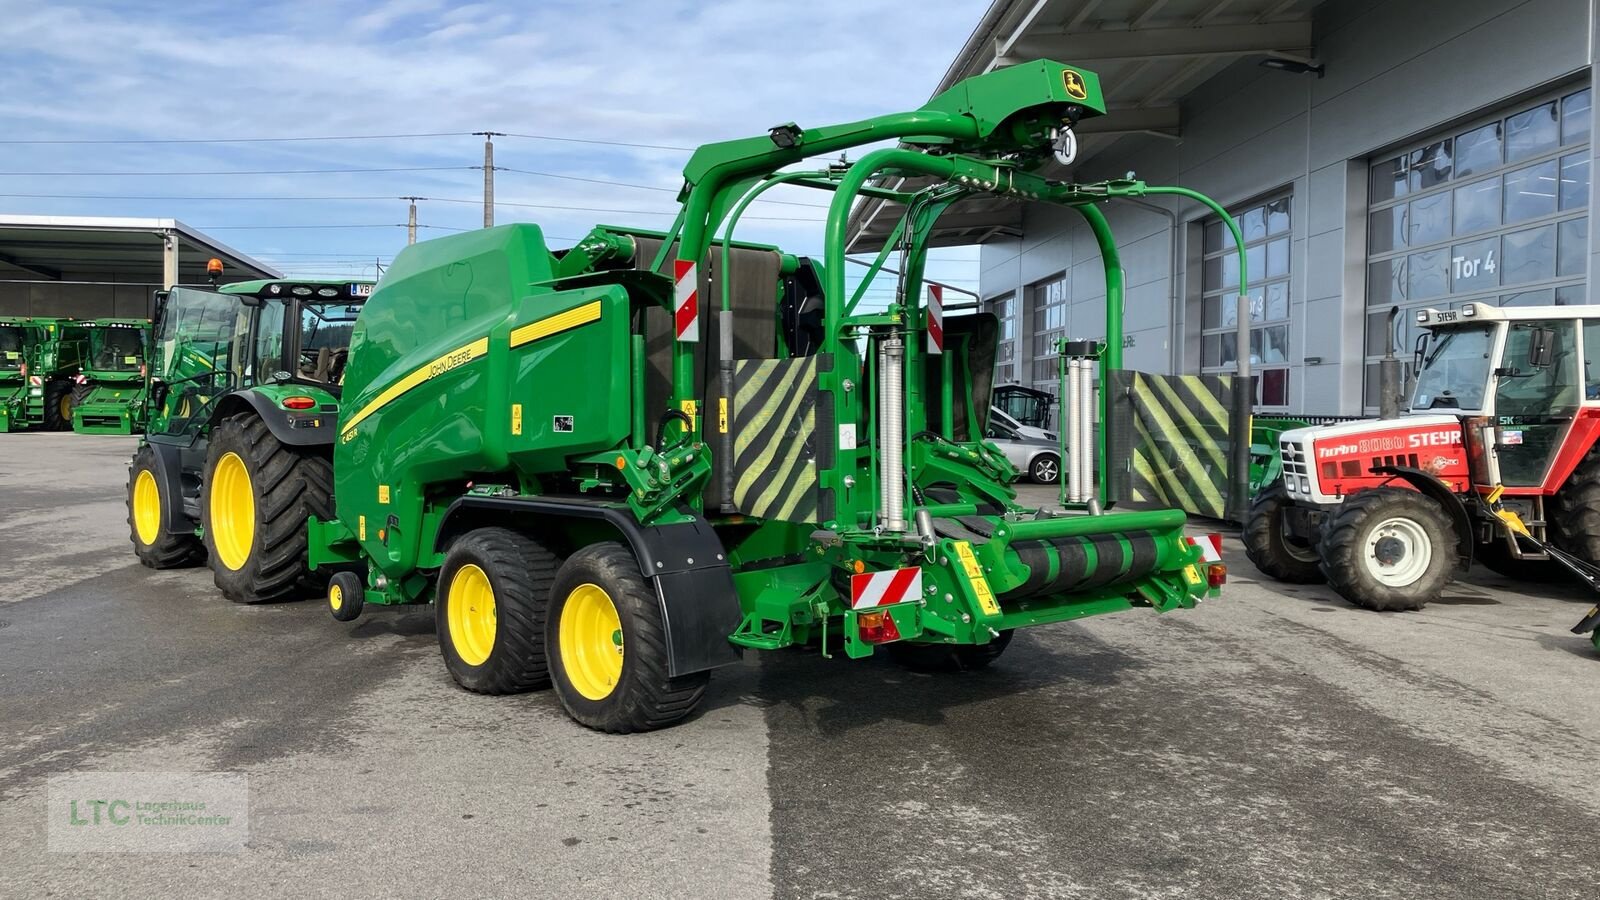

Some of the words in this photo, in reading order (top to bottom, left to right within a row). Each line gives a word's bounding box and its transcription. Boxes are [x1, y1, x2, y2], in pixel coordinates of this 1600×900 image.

[1453, 256, 1480, 279] Tor
[1484, 250, 1496, 274] 4
[1258, 295, 1263, 312] 3
[1437, 311, 1457, 322] STEYR
[428, 359, 447, 378] JOHN
[447, 348, 472, 368] DEERE
[1319, 444, 1359, 458] Turbo
[1359, 436, 1405, 453] 8080
[1408, 430, 1461, 447] STEYR
